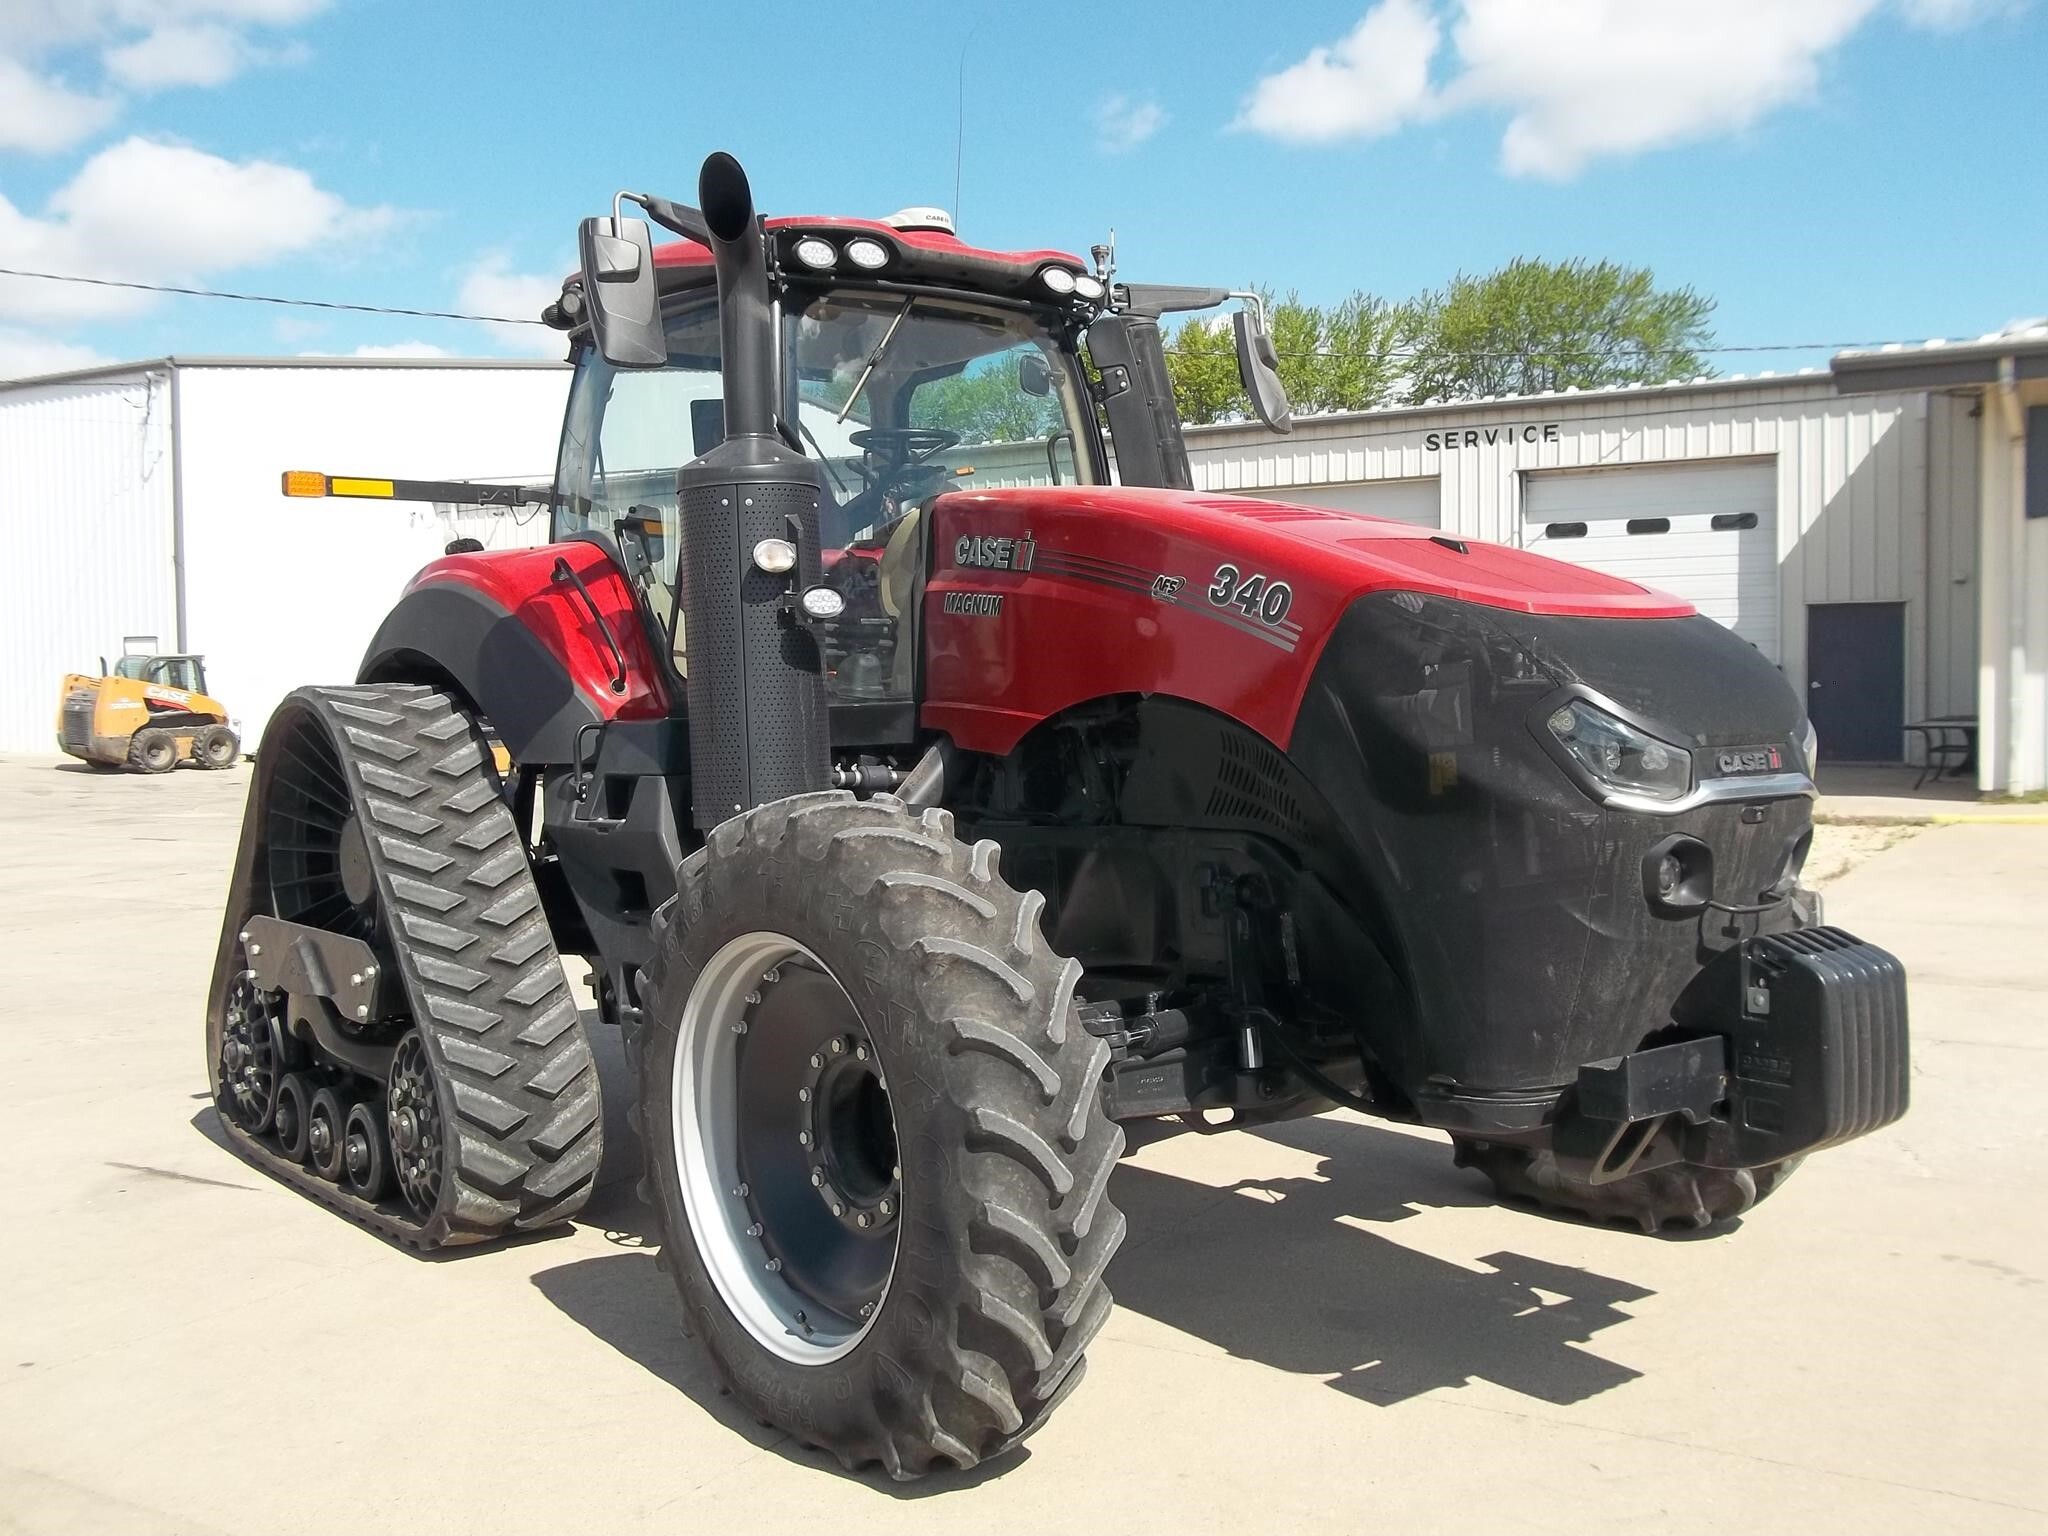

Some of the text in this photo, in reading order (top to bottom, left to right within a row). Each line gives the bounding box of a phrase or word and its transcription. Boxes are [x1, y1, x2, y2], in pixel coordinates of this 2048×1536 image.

[926, 214, 944, 222] CASE
[1425, 424, 1559, 451] SERVICE
[955, 535, 1012, 569] CASE
[1152, 574, 1180, 594] AFS
[1208, 564, 1292, 626] 340
[943, 592, 1003, 616] MAGNUM
[1719, 752, 1768, 773] CASE
